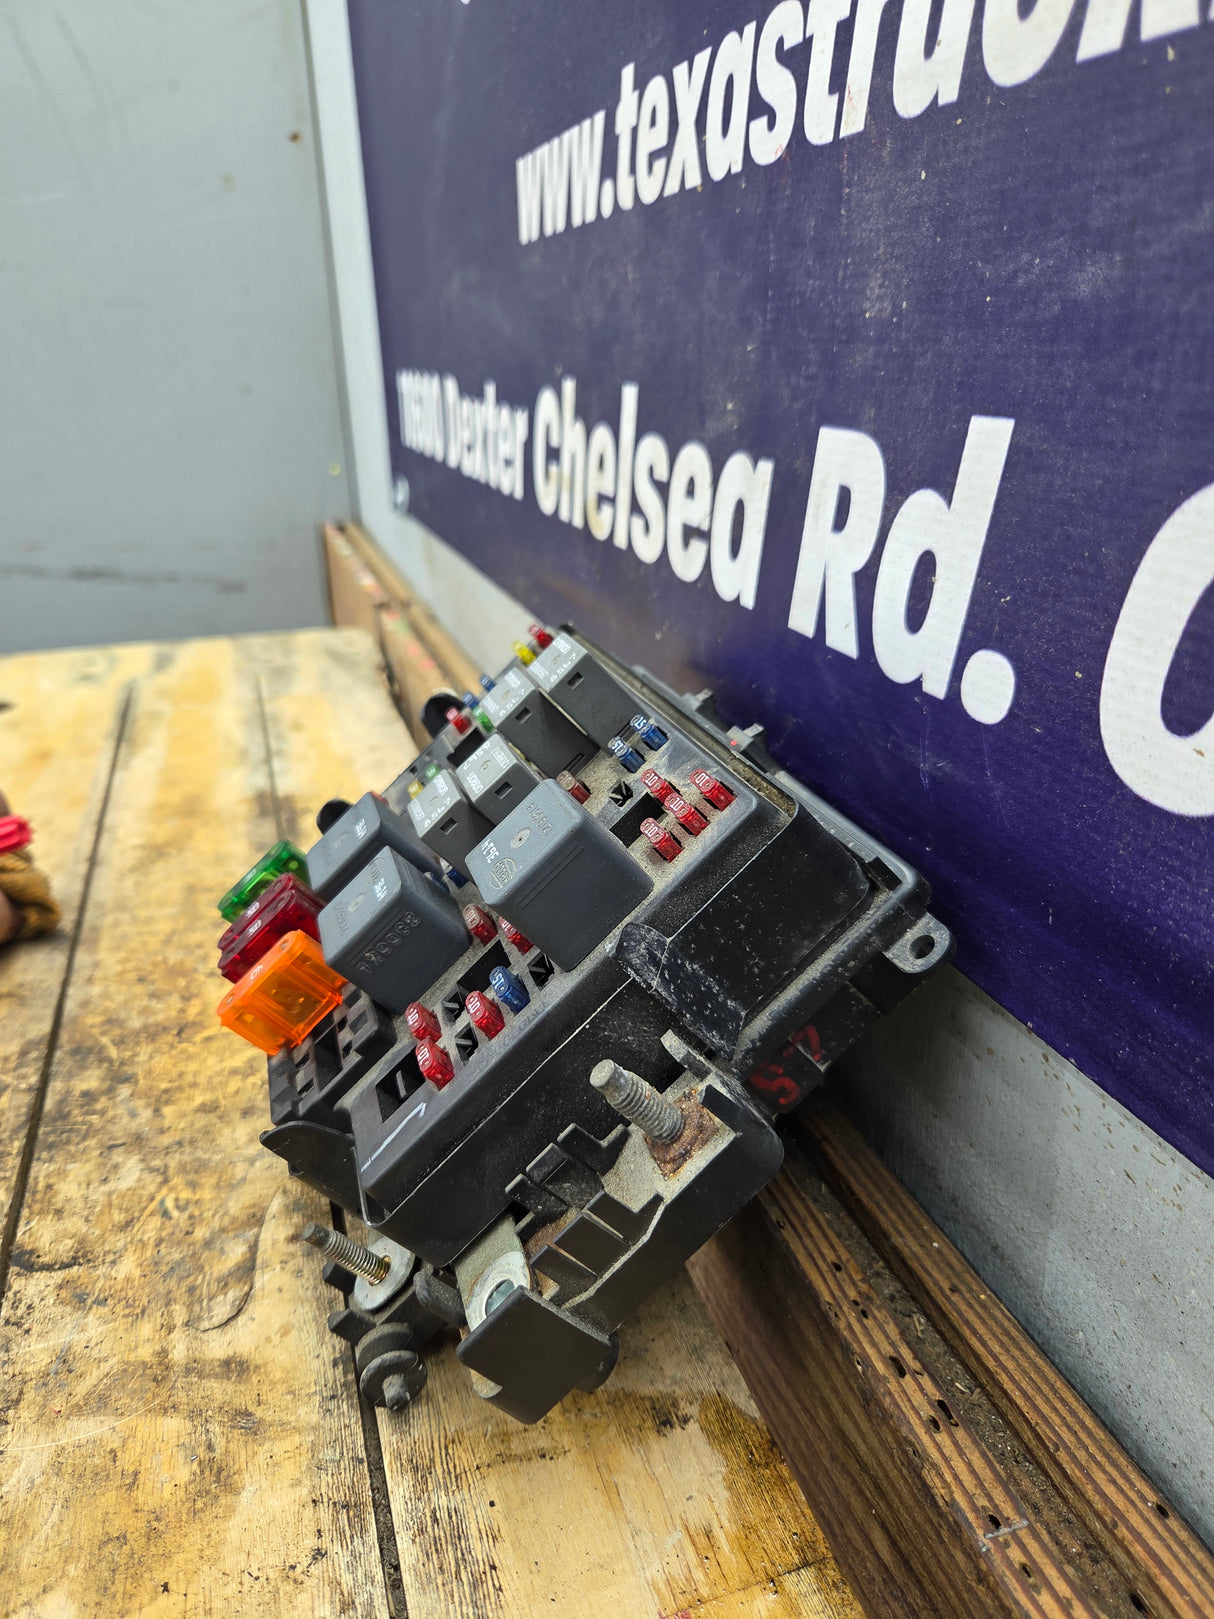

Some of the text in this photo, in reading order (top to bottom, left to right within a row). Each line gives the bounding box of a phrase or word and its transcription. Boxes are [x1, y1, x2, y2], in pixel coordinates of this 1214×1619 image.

[442, 371, 530, 501] Dexter
[532, 376, 775, 610] Chelsea
[787, 414, 1016, 726] Rd.
[634, 716, 648, 730] 15
[611, 739, 624, 753] 15
[645, 773, 659, 787] 10
[695, 772, 710, 787] 10
[669, 797, 685, 812] 10
[644, 823, 659, 838] 10
[467, 995, 481, 1015] 10
[408, 1007, 420, 1026] 10
[416, 1051, 431, 1071] 10
